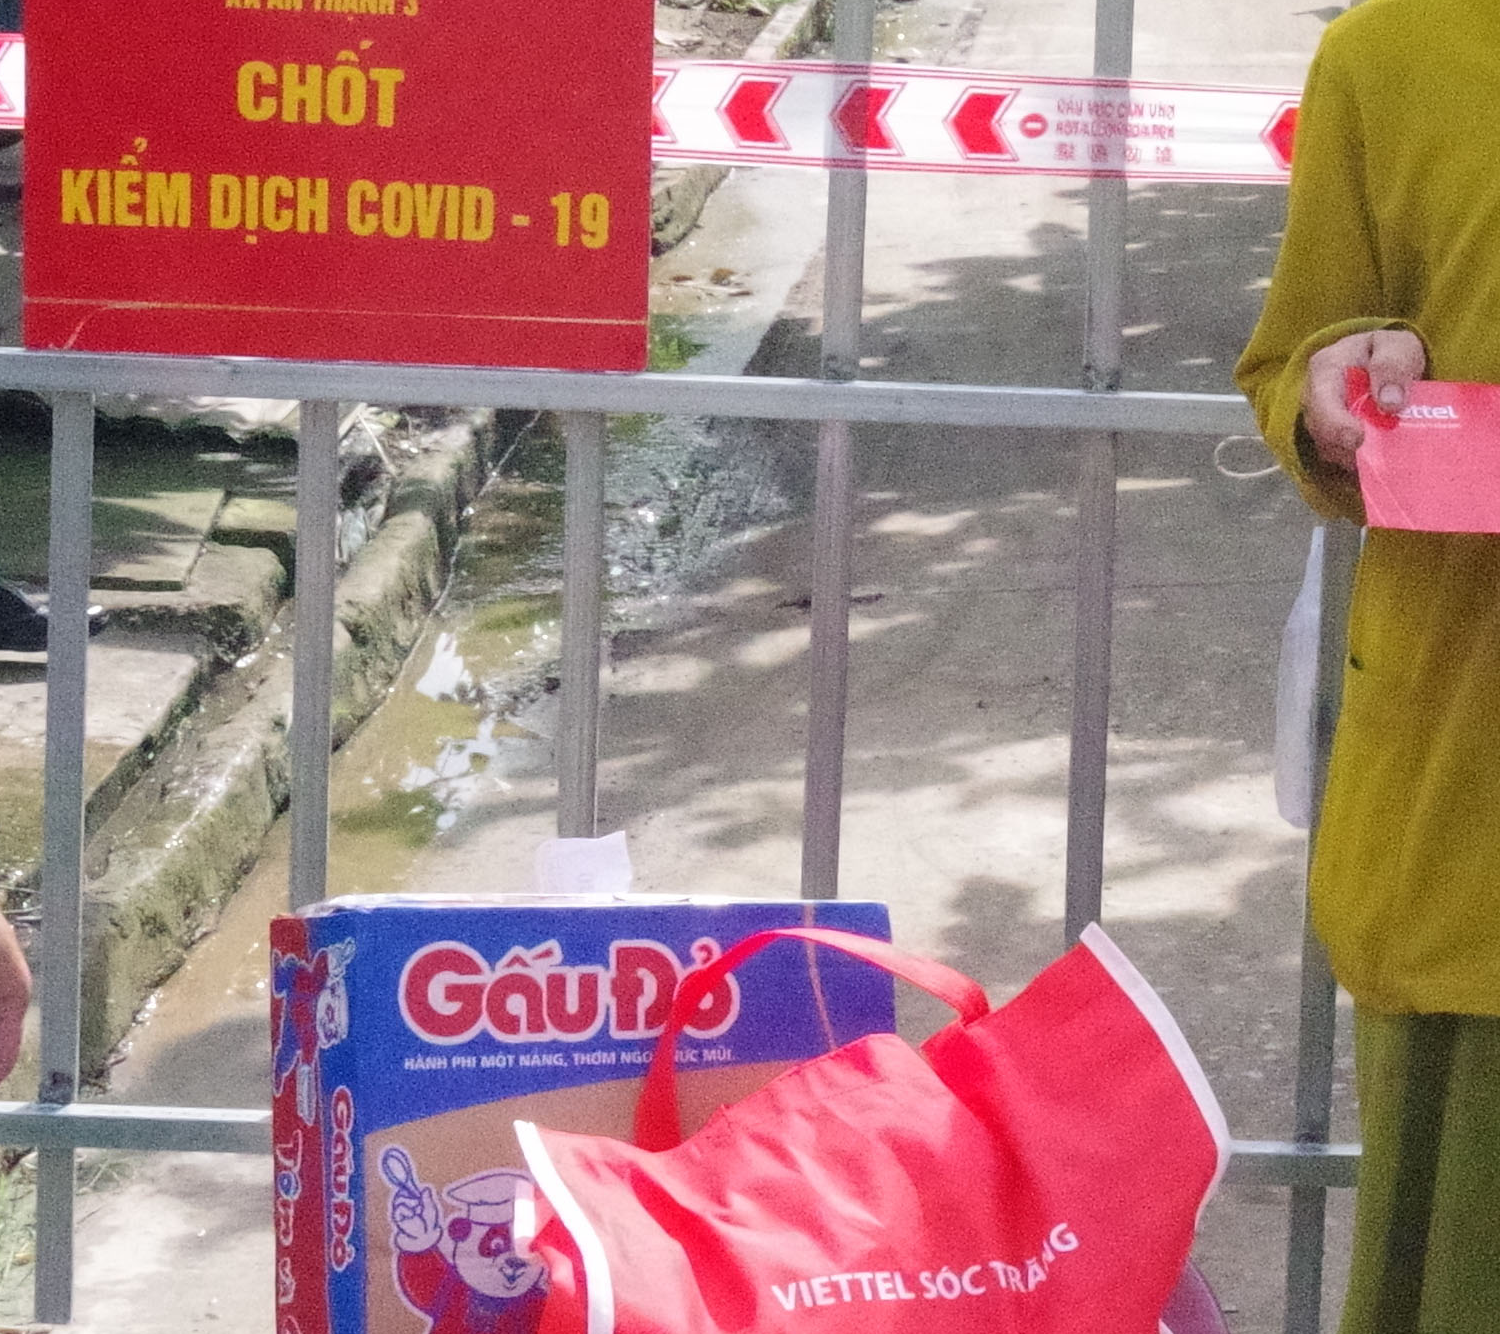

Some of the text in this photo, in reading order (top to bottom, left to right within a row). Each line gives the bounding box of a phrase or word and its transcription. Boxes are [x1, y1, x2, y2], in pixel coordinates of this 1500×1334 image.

[236, 40, 405, 128] CHỐT
[60, 137, 192, 229] KIỂM
[209, 174, 329, 245] DỊCH
[346, 180, 495, 242] COVID
[551, 194, 610, 249] 19
[398, 939, 606, 1046] Gấu
[620, 1050, 654, 1065] NGO
[771, 1270, 916, 1311] VIETTEL
[918, 1264, 986, 1300] SÓC
